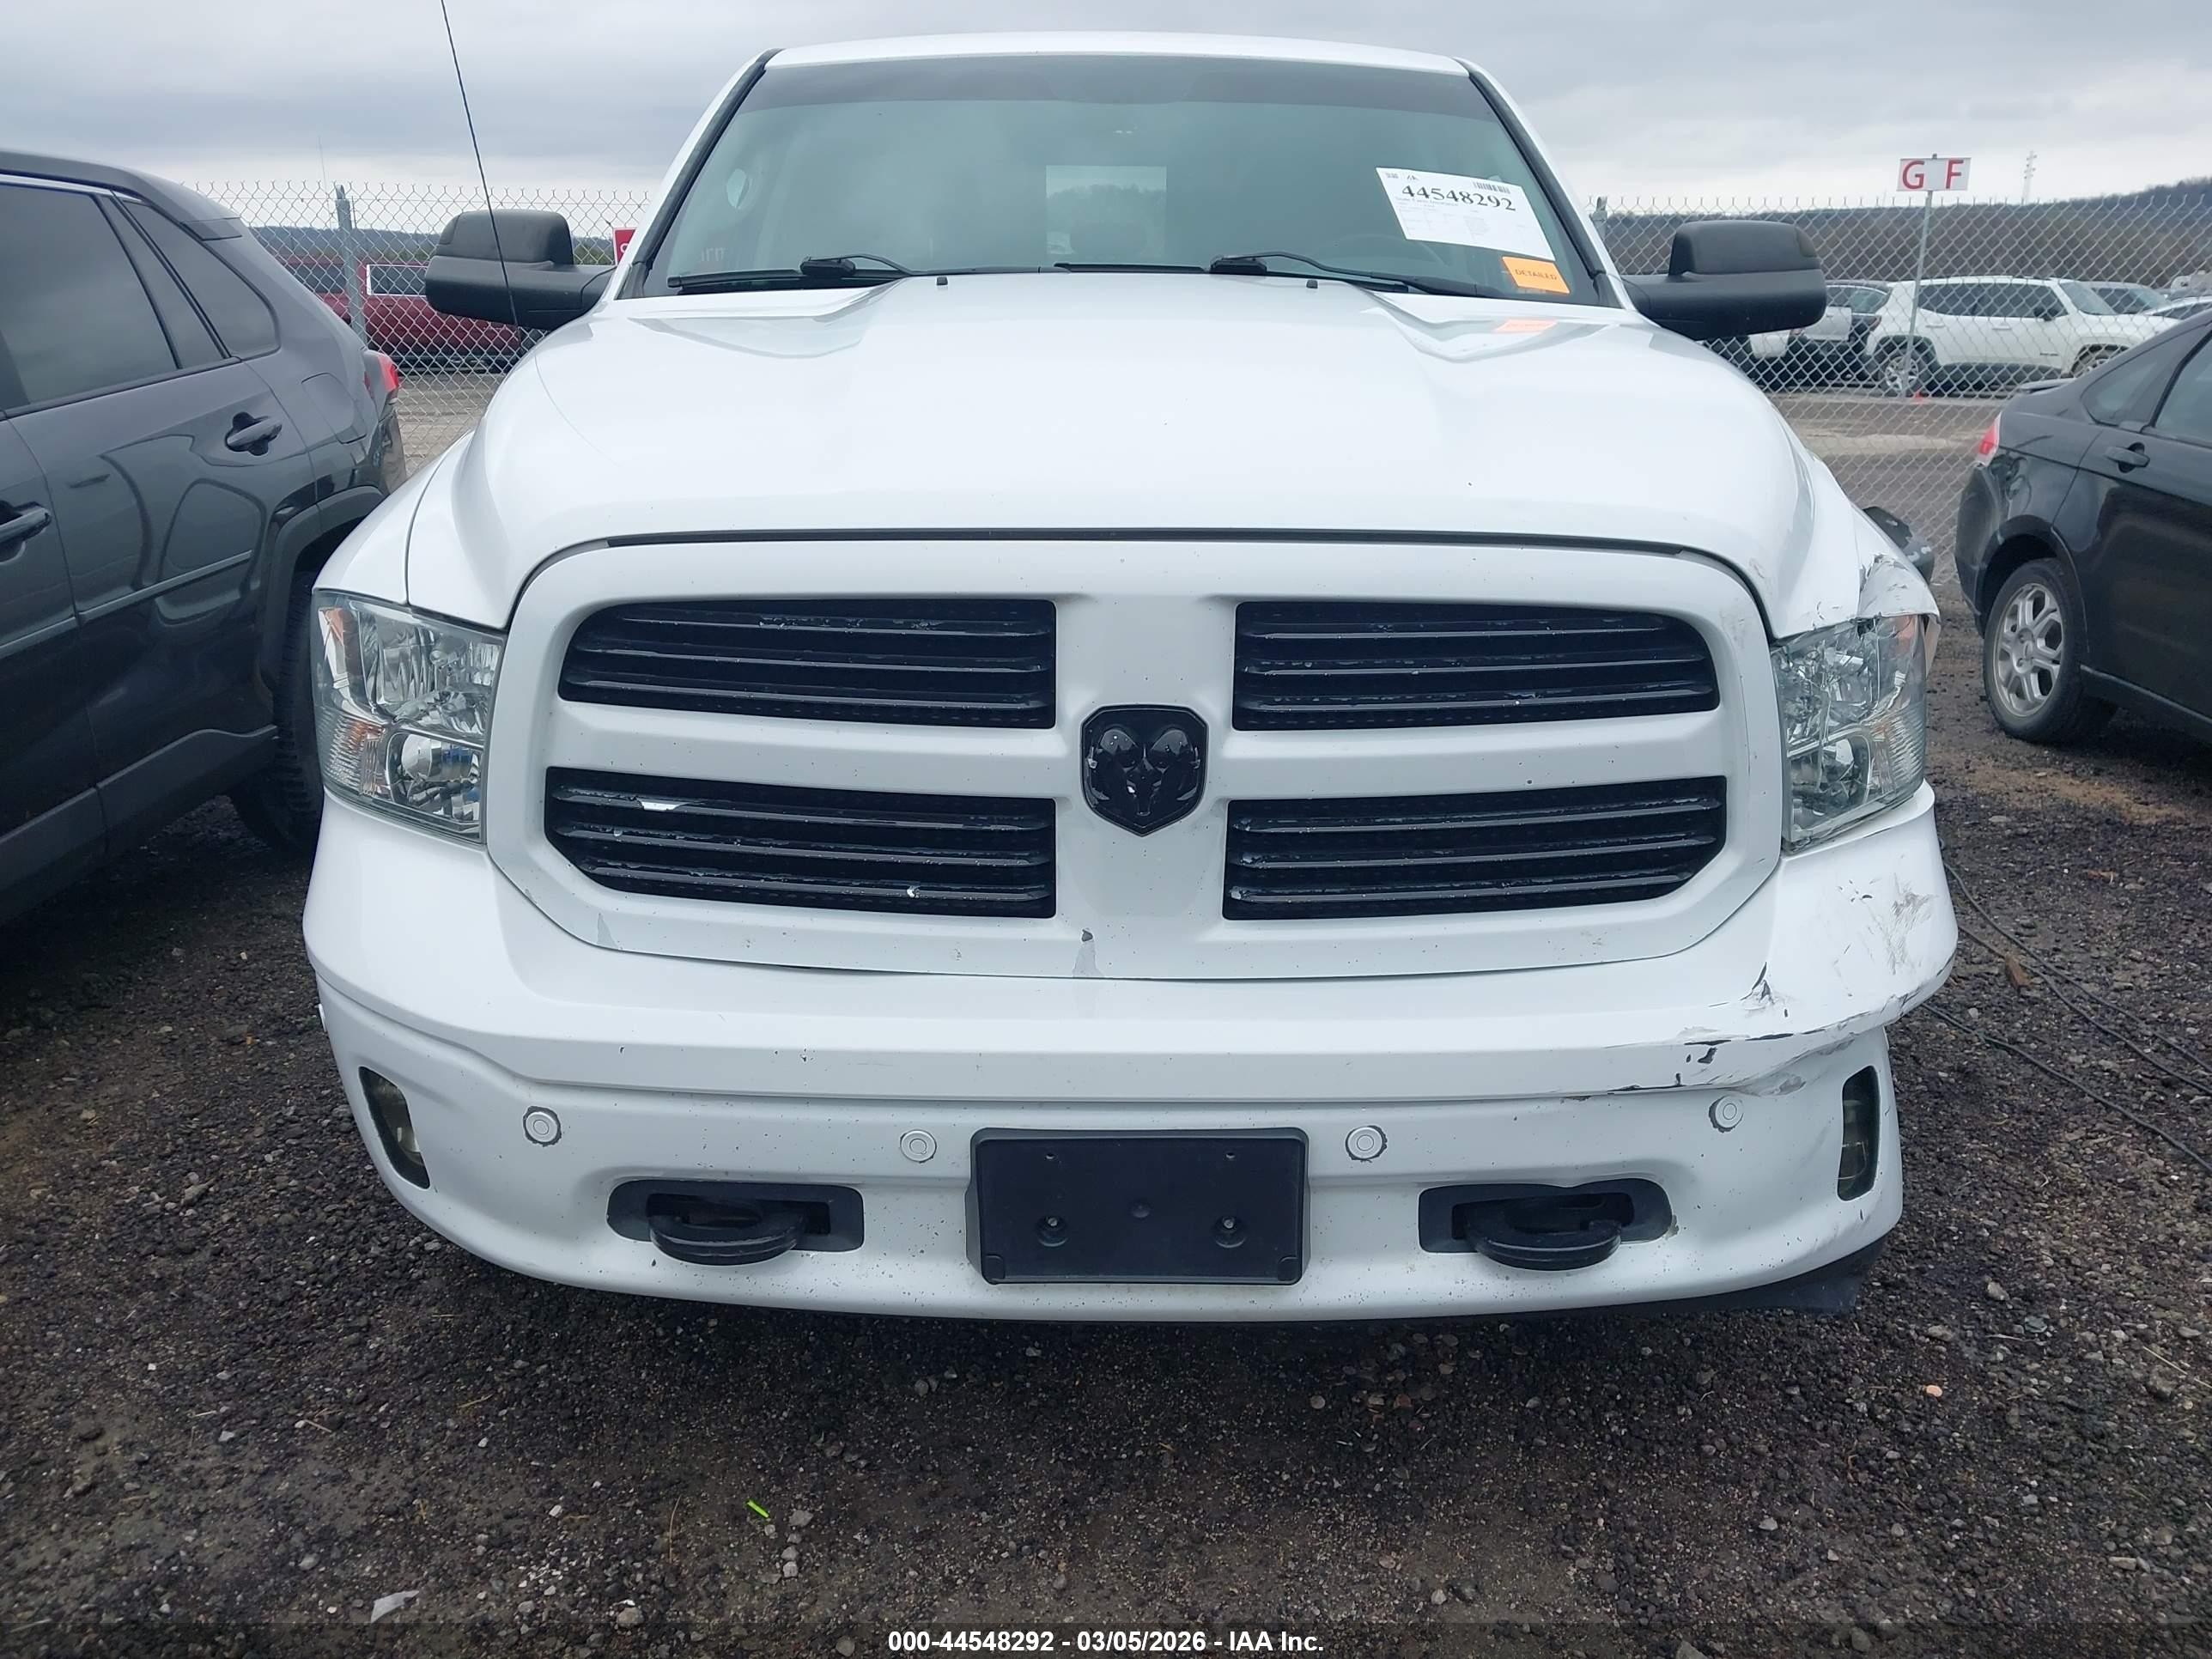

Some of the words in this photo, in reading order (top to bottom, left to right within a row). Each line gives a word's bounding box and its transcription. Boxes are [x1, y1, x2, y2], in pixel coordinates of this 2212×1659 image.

[1903, 161, 1924, 189] G
[1946, 160, 1964, 189] F
[1402, 185, 1516, 210] 44548292
